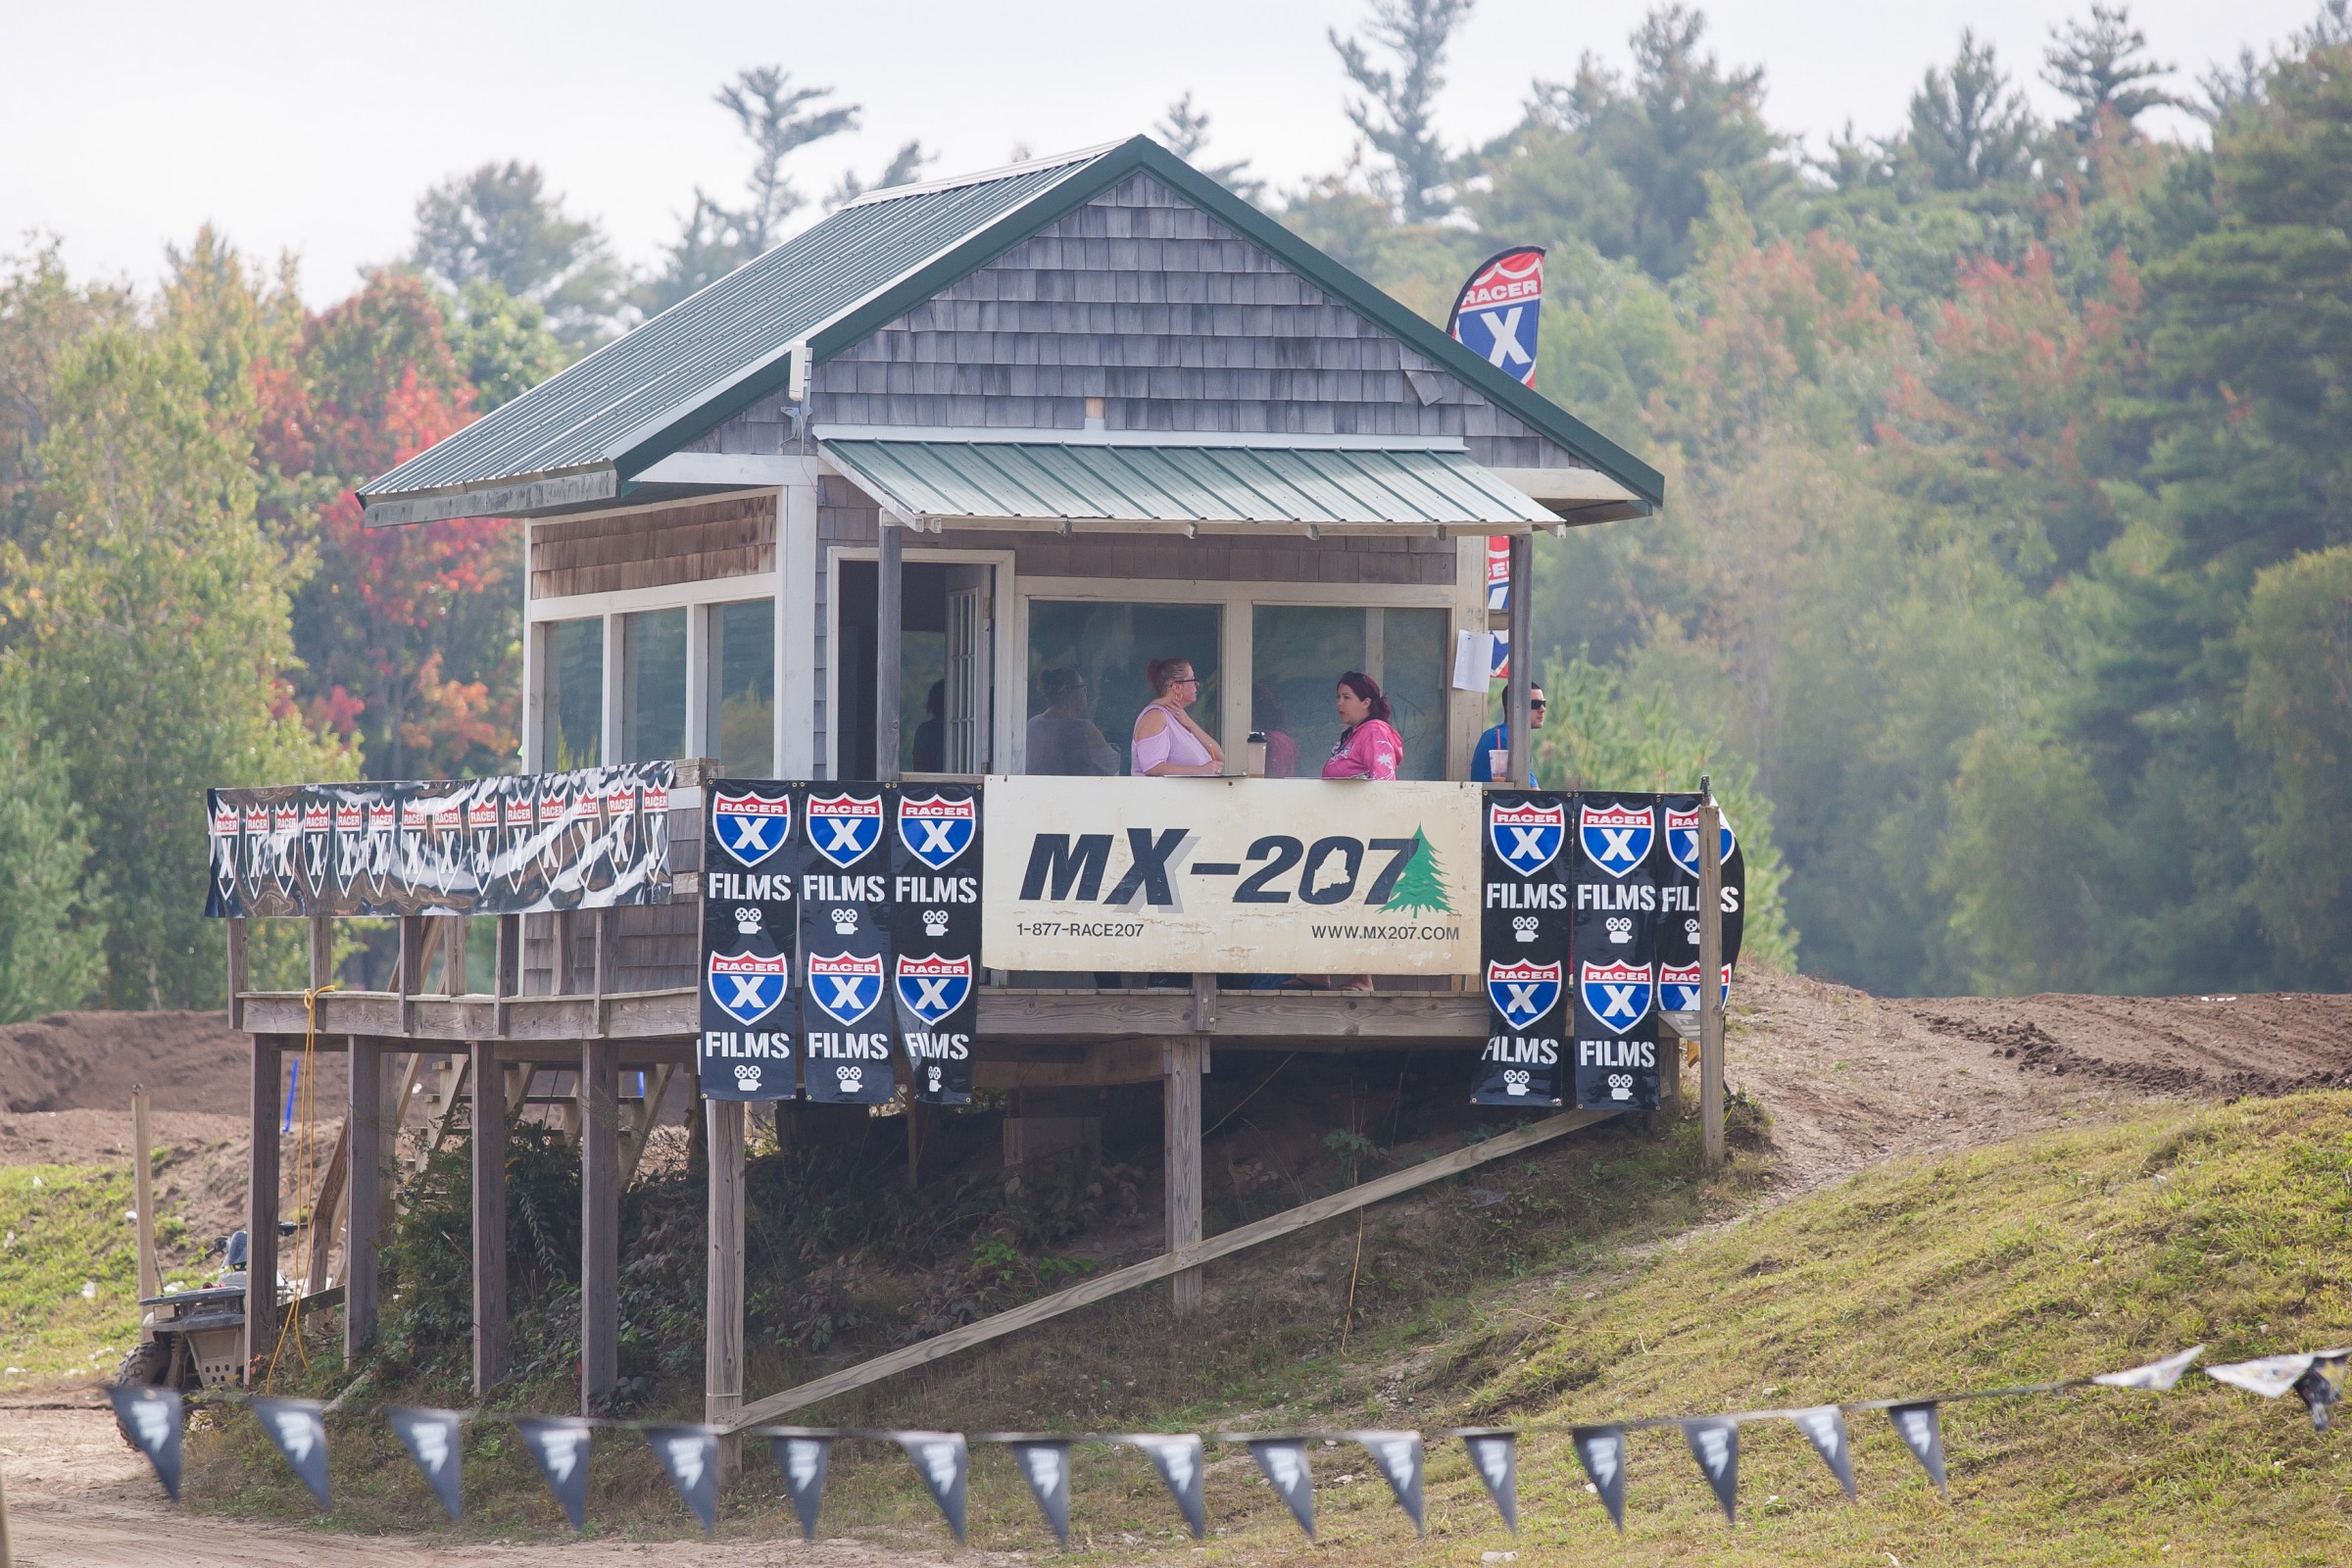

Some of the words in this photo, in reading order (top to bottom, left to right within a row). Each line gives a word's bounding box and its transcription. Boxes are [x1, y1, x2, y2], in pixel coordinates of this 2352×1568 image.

[1462, 280, 1538, 306] RACER
[1480, 307, 1533, 368] X
[508, 809, 531, 820] RACER
[541, 806, 564, 818] RACER
[573, 802, 598, 815] RACER
[610, 799, 634, 811] RACER
[645, 796, 667, 808] RACER
[720, 804, 783, 814] RACER
[812, 805, 876, 814] RACER
[906, 807, 969, 816] RACER
[217, 820, 237, 831] RACER
[247, 818, 268, 829] RACER
[276, 818, 297, 829] RACER
[306, 816, 328, 827] RACER
[338, 815, 360, 826] RACER
[371, 814, 393, 825] RACER
[404, 813, 425, 824] RACER
[435, 812, 459, 823] RACER
[470, 810, 496, 822] RACER
[1496, 813, 1557, 823] RACER
[1587, 815, 1647, 825] RACER
[732, 817, 769, 850] X
[826, 818, 862, 852] X
[919, 820, 956, 853] X
[1509, 827, 1545, 860] X
[1599, 828, 1636, 861] X
[219, 838, 234, 878] X
[250, 836, 263, 877] X
[310, 834, 323, 876] X
[340, 834, 355, 875] X
[372, 833, 387, 875] X
[406, 832, 420, 874] X
[440, 831, 455, 873] X
[476, 830, 490, 873] X
[1019, 827, 1421, 906] MX-207
[709, 872, 791, 901] FILMS
[804, 875, 885, 903] FILMS
[896, 876, 977, 904] FILMS
[1487, 883, 1567, 909] FILMS
[1577, 884, 1656, 911] FILMS
[1662, 886, 1739, 913] FILS
[1016, 922, 1145, 937] 1-877-RACE207
[1311, 925, 1459, 941] WWW.MX207.COM
[715, 961, 780, 972] RACER
[814, 962, 877, 973] RACER
[903, 964, 965, 974] RACER
[1494, 970, 1554, 980] RACER
[1588, 971, 1648, 982] RACER
[729, 976, 766, 1008] X
[829, 976, 865, 1009] X
[914, 979, 949, 1009] X
[1507, 984, 1540, 1013] X
[1602, 985, 1638, 1017] X
[706, 1031, 790, 1058] FILMS
[808, 1033, 888, 1059] FILMS
[1580, 1040, 1655, 1067] FILMS
